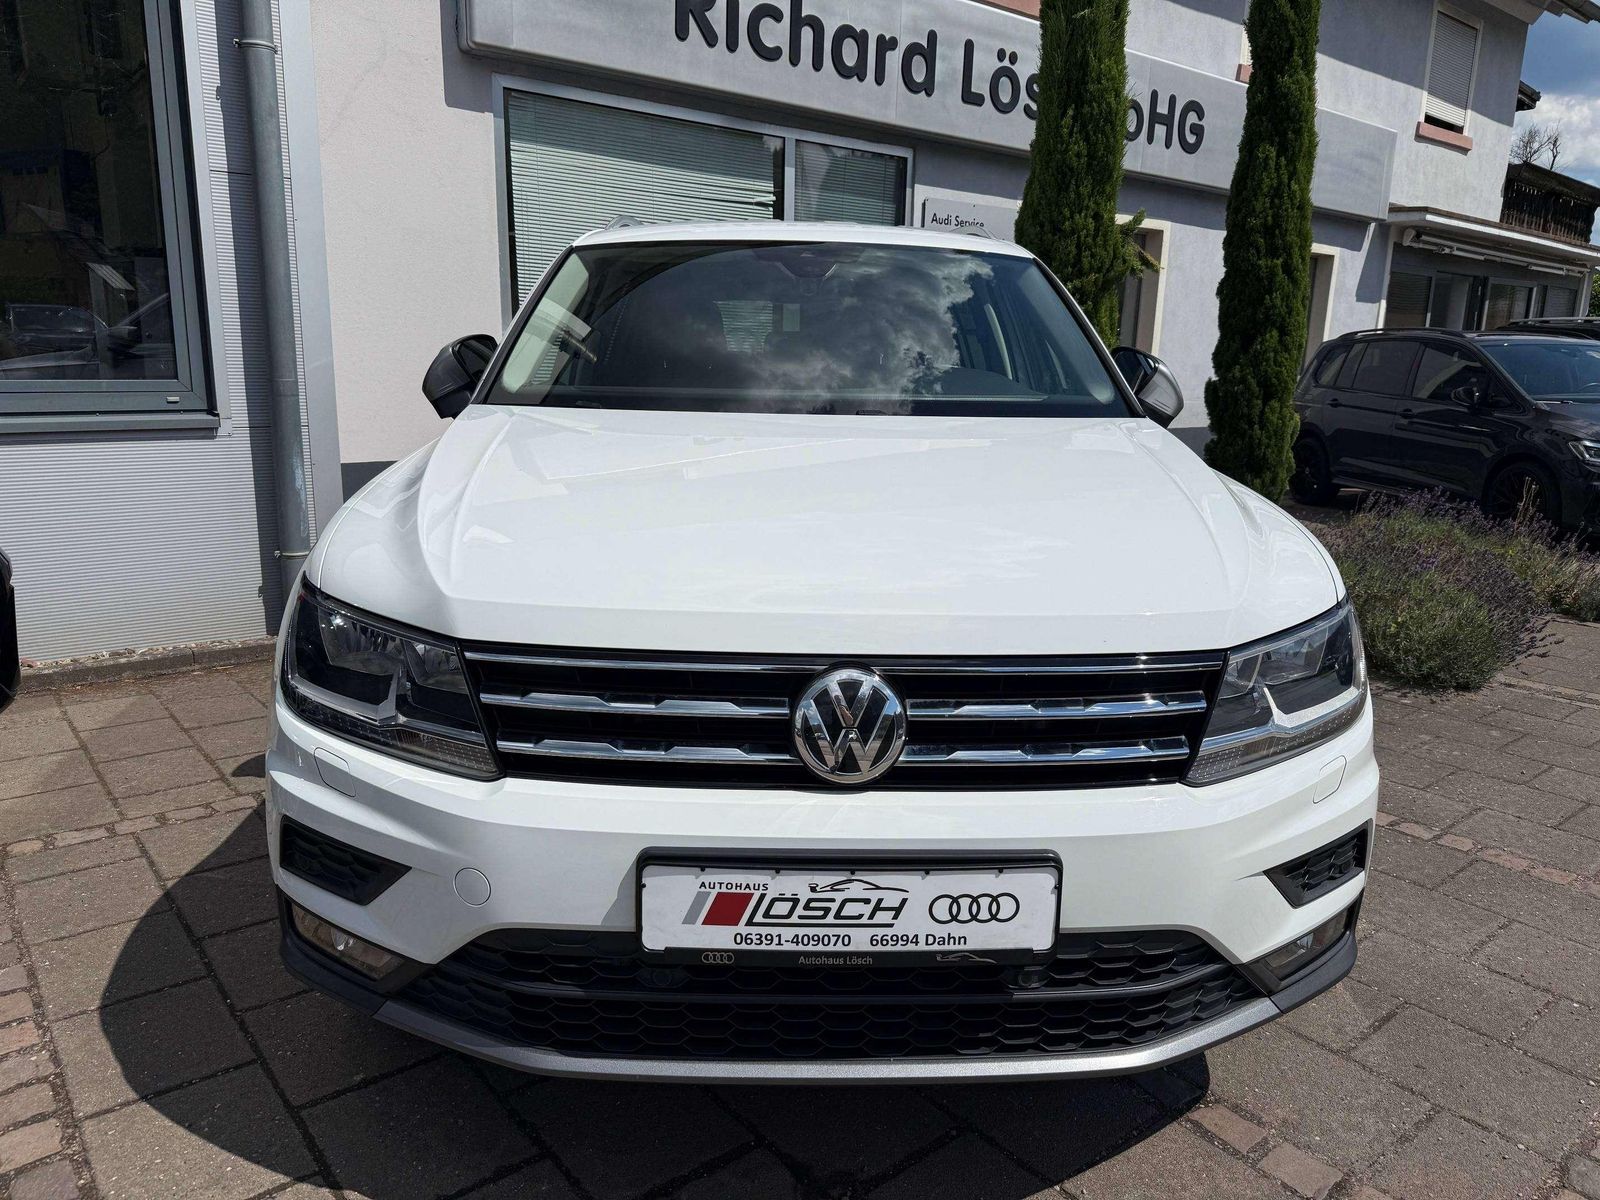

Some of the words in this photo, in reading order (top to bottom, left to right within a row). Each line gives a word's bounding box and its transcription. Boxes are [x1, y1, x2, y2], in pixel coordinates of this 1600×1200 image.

[675, 0, 938, 97] Richard
[961, 38, 1040, 121] Lös
[931, 213, 952, 226] Audi
[698, 881, 770, 892] AUTOHAUS
[744, 892, 909, 928] LÖSCH
[733, 932, 852, 948] 06391-409070
[869, 934, 920, 948] 66994
[924, 933, 968, 947] Dahn
[798, 955, 844, 966] Autohaus
[846, 956, 874, 966] Lösch
